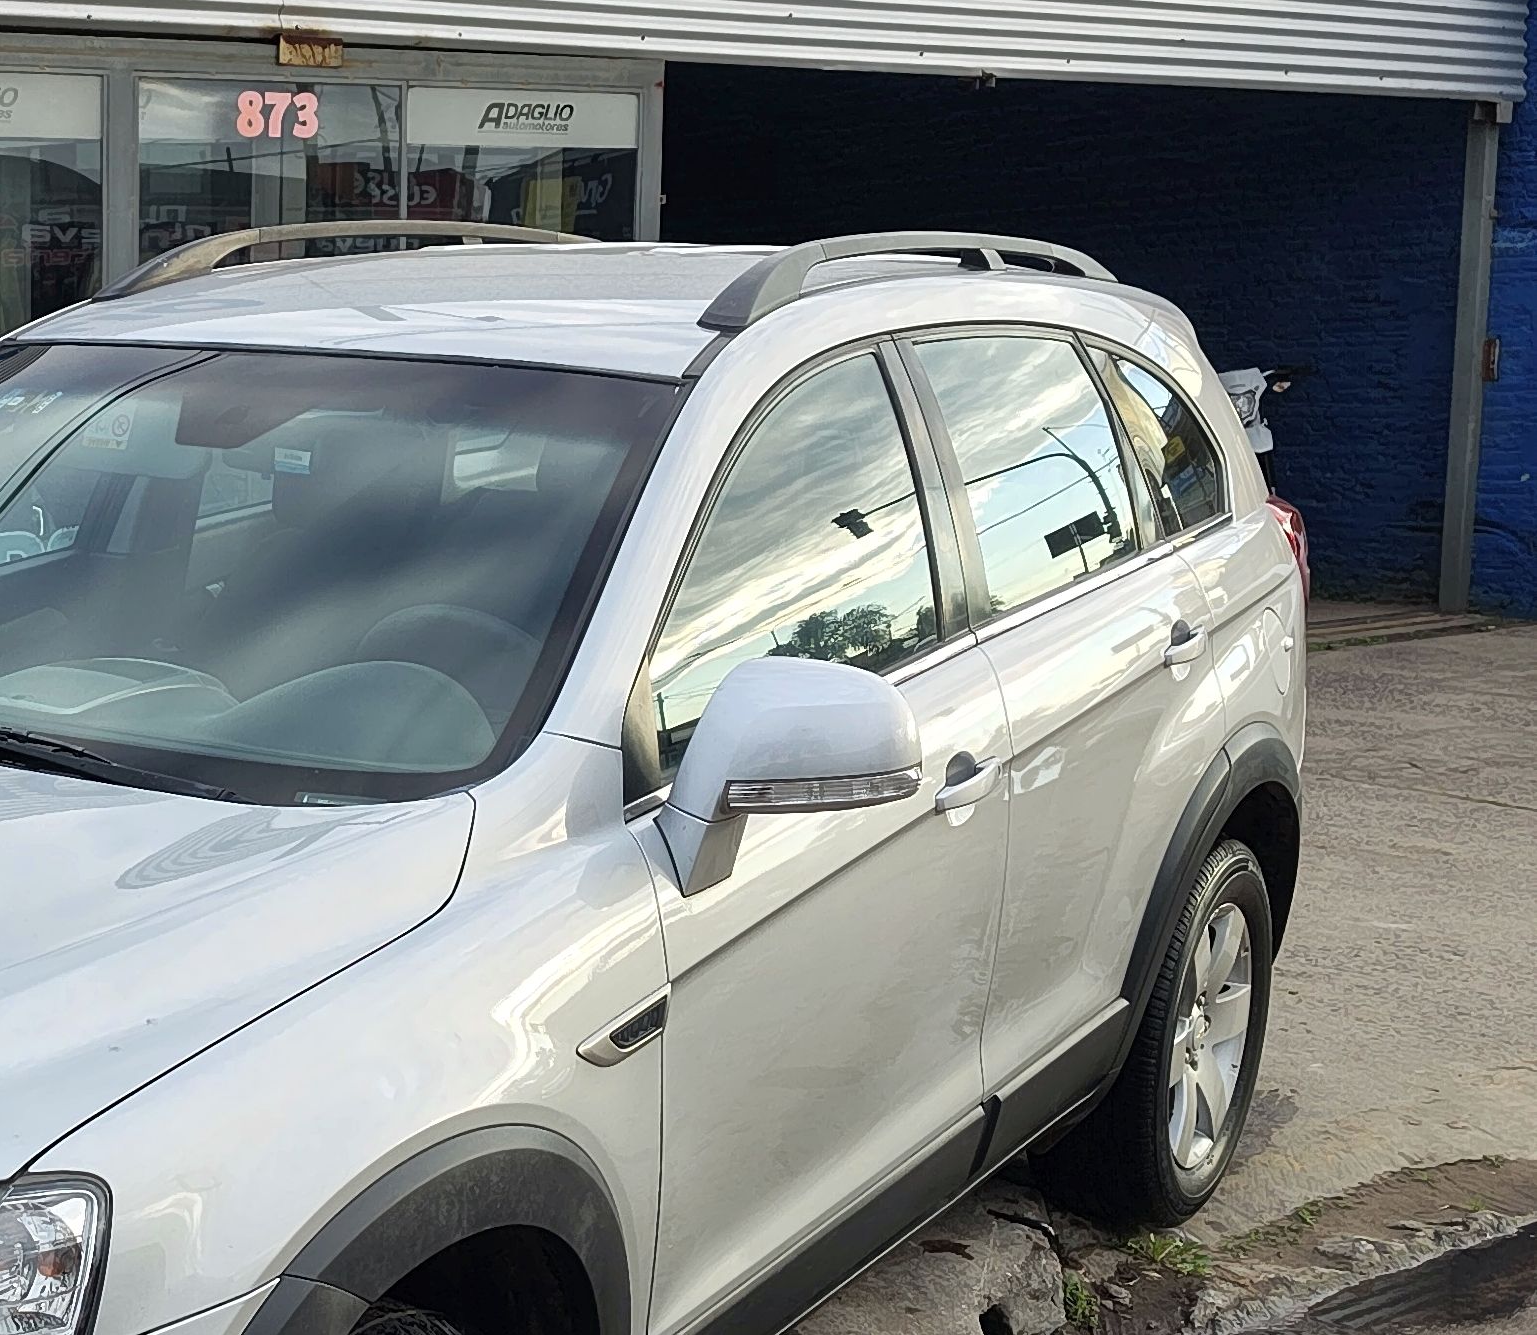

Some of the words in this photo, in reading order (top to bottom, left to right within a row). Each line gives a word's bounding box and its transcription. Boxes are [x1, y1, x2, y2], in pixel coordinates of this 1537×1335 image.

[237, 90, 319, 138] 873
[478, 102, 574, 129] ADAGLIO
[502, 119, 568, 132] automotores
